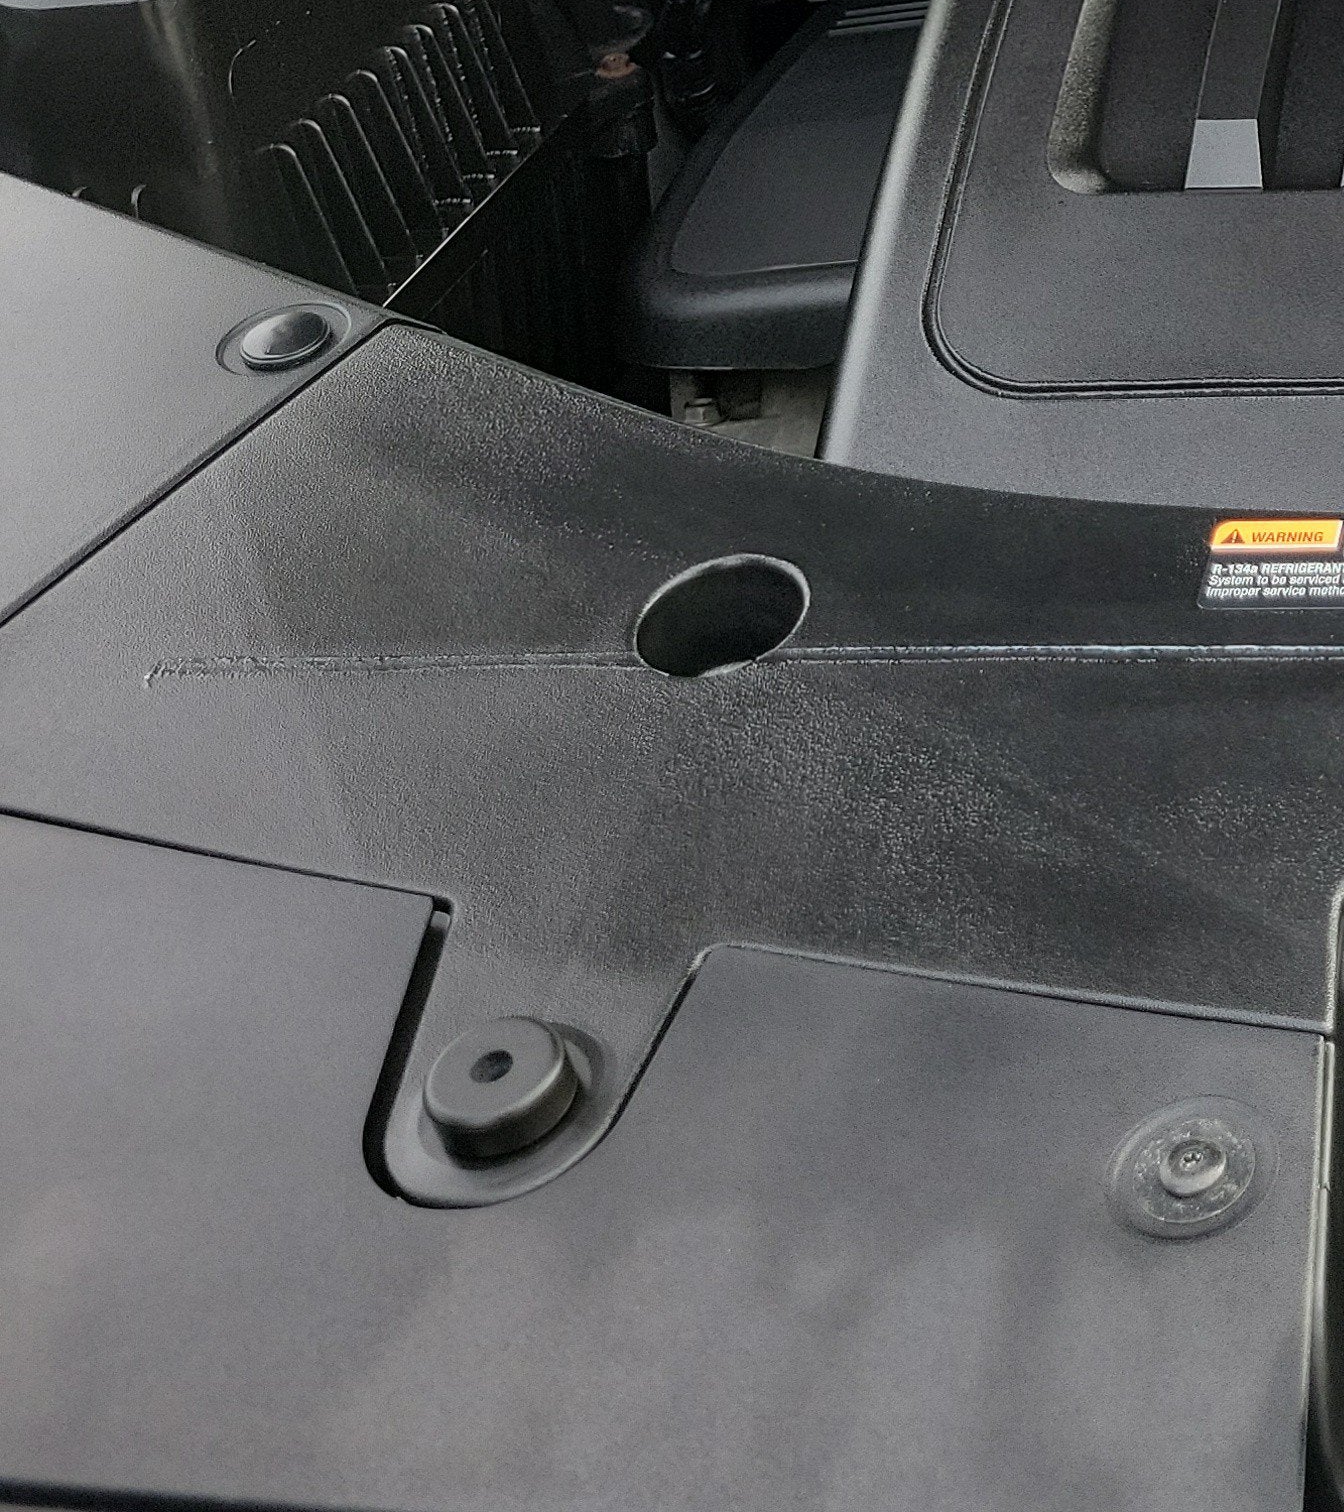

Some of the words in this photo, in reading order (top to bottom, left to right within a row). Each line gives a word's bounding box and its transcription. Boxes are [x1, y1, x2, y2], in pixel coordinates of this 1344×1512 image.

[1252, 531, 1324, 542] WARNING
[1212, 563, 1258, 575] R-134a
[1209, 575, 1254, 587] System
[1257, 575, 1268, 586] to
[1272, 575, 1286, 586] be
[1289, 574, 1341, 585] serviced
[1206, 586, 1259, 598] Improper
[1263, 586, 1306, 596] service
